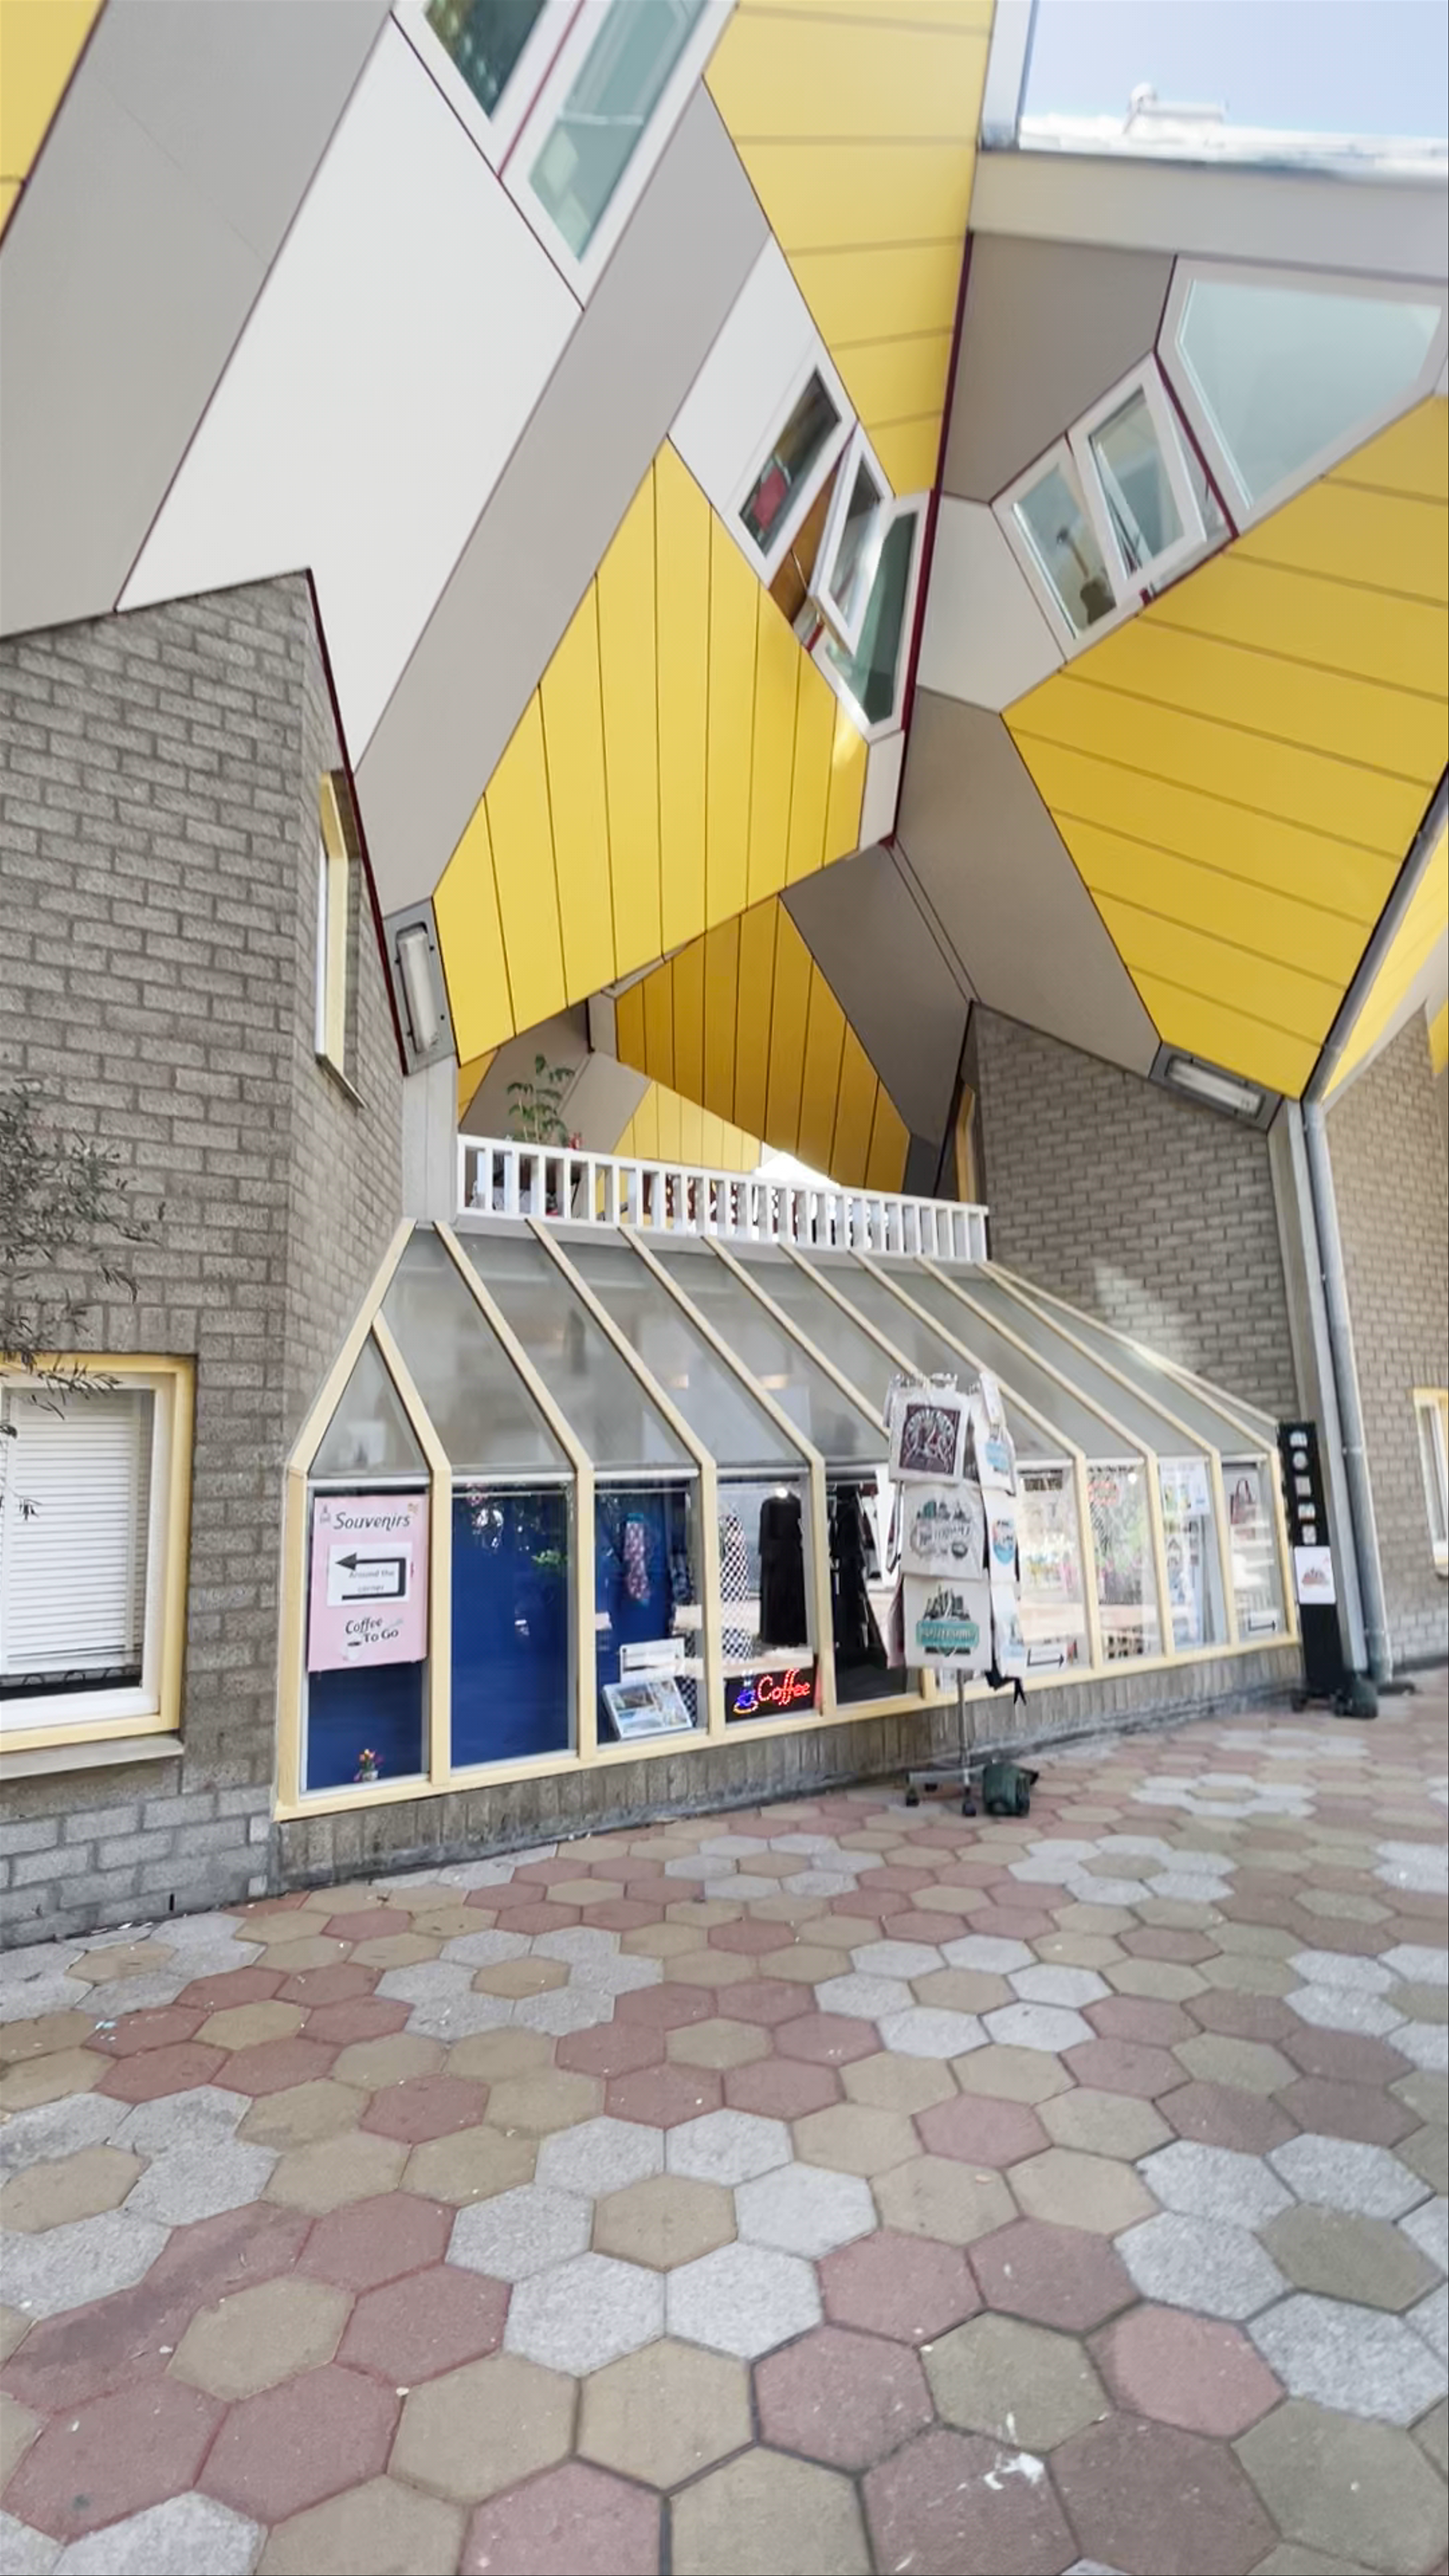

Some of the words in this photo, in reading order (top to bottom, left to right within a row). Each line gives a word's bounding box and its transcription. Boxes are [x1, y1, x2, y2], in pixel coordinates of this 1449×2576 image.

[334, 1511, 410, 1531] Souvenirs
[349, 1570, 379, 1578] Around
[345, 1617, 383, 1634] Coffee
[364, 1632, 379, 1642] To
[381, 1629, 398, 1639] Go
[757, 1668, 810, 1706] Coffee
